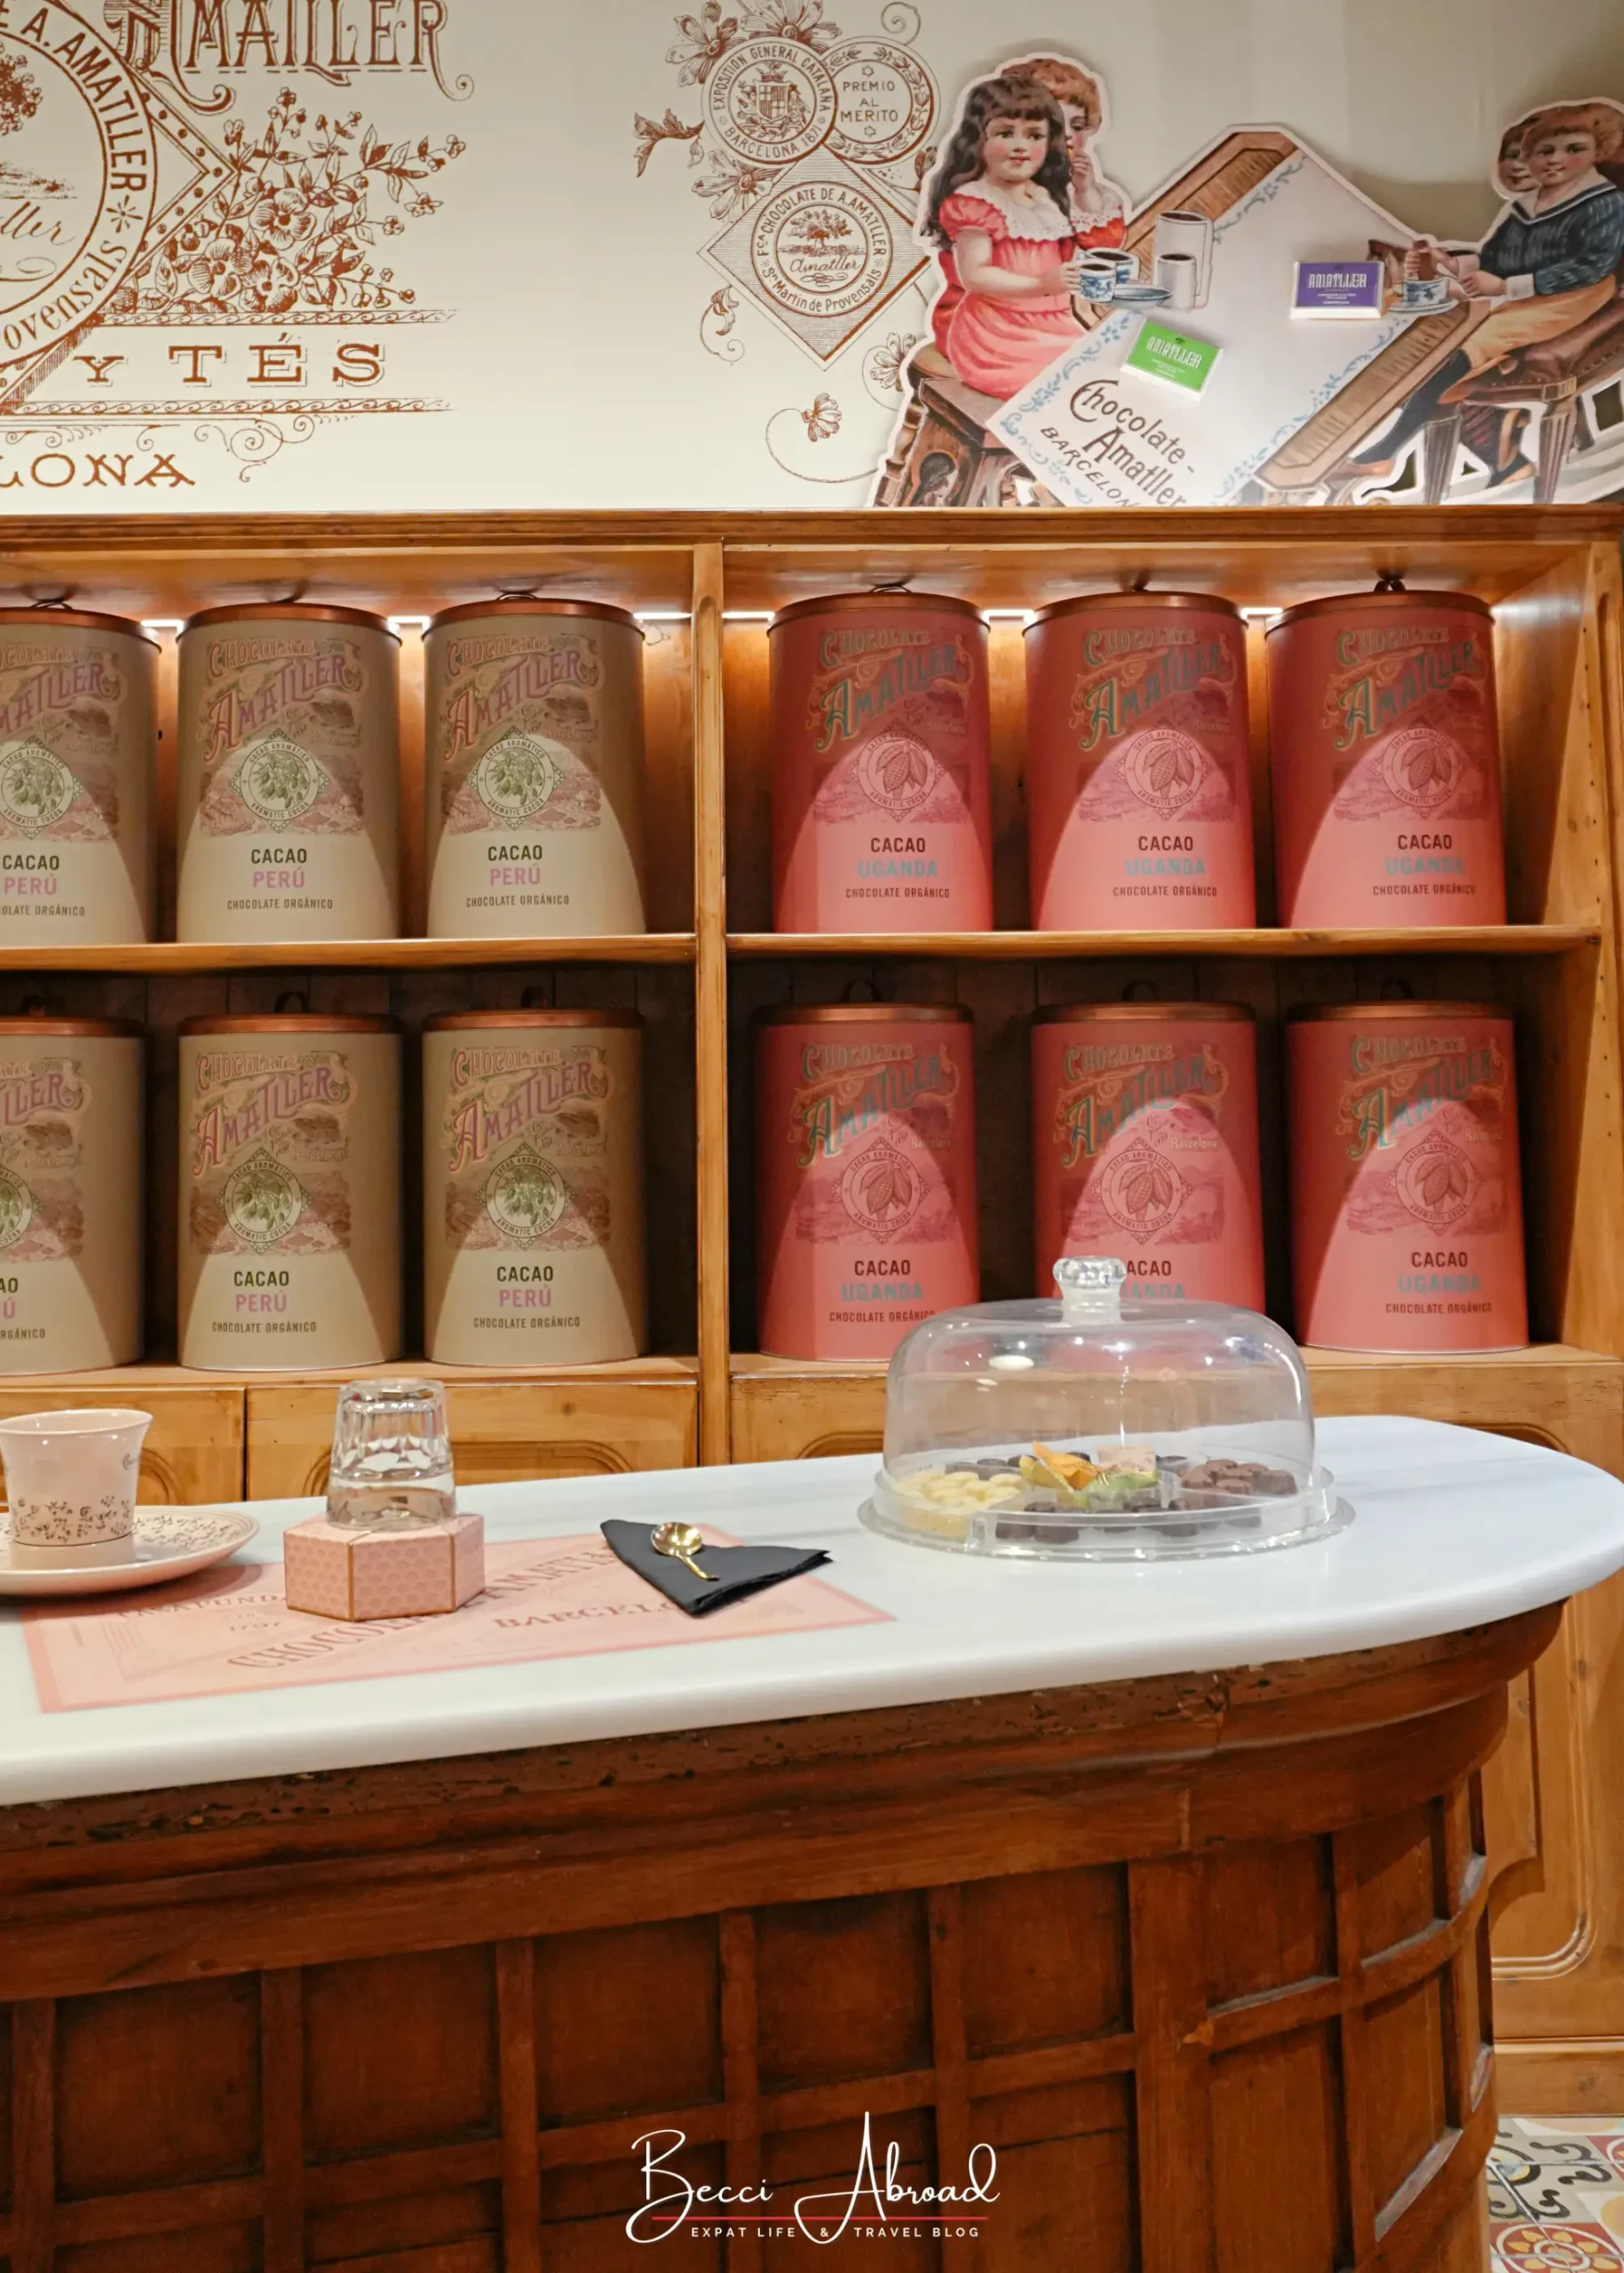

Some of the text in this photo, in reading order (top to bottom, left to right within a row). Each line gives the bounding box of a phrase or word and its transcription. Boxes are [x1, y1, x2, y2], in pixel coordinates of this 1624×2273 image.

[713, 45, 833, 112] EXPOSITION GENERAL CATALANA
[843, 81, 895, 92] PREMIO
[859, 97, 880, 107] AL
[52, 32, 147, 192] AMATLLER
[840, 109, 899, 123] MERITO
[724, 124, 823, 159] BARCELONA 1871
[761, 187, 816, 234] CHOCOLATE
[820, 187, 835, 201] DE
[825, 268, 882, 311] Provensals
[74, 331, 388, 388] Y TÉS
[1081, 426, 1188, 507] Amatller
[820, 629, 931, 668] CHOCOLATE
[444, 649, 586, 760] AMATLLER
[813, 645, 959, 752] AMATLLER
[1079, 644, 1225, 752] AMATLLER
[1335, 640, 1477, 752] AMATLLER
[203, 654, 346, 762] AMATLLER
[487, 844, 543, 861] CACAO
[870, 837, 926, 853] CACAO
[1138, 836, 1194, 851] CACAO
[1398, 835, 1452, 851] CACAO
[3, 854, 59, 870] CACAO
[250, 848, 307, 864] CACAO
[489, 863, 541, 886] PERÚ
[858, 859, 939, 878] UGANDA
[1125, 858, 1206, 876] UGANDA
[1385, 857, 1463, 875] UGANDA
[4, 873, 57, 895] PERÚ
[252, 867, 305, 889] PERÚ
[845, 884, 950, 899] CHOCOLATE ORGÁNICO
[1113, 884, 1217, 897] CHOCOLATE ORGÁNICO
[1373, 885, 1429, 896] CHOCOLATE
[36, 904, 85, 916] ORGÁNICO
[227, 896, 333, 910] CHOCOLATE ORGÁNICO
[466, 894, 569, 908] CHOCOLATE ORGÁNICO
[803, 1044, 914, 1081] CHOCOLATE
[797, 1055, 947, 1167] AMATLLER
[1062, 1056, 1215, 1168] AMATLLER
[1348, 1049, 1492, 1160] AMATLLER
[192, 1066, 334, 1176] AMATLLER
[448, 1062, 597, 1172] AMATLLER
[854, 1260, 910, 1276] CACAO
[1126, 1260, 1171, 1276] ACAO
[1411, 1252, 1468, 1268] CACAO
[234, 1271, 289, 1287] CACAO
[496, 1266, 553, 1282] CACAO
[1398, 1274, 1479, 1293] UGANDA
[235, 1290, 287, 1312] PERÚ
[499, 1284, 551, 1307] PERÚ
[841, 1282, 923, 1302] UGANDA
[829, 1312, 884, 1323] CHOCOLATE
[1385, 1303, 1444, 1314] CHOCOLATE
[212, 1320, 316, 1333] CHOCOLATE ORGÁNICO
[473, 1315, 580, 1328] CHOCOLATE ORGÁNICO
